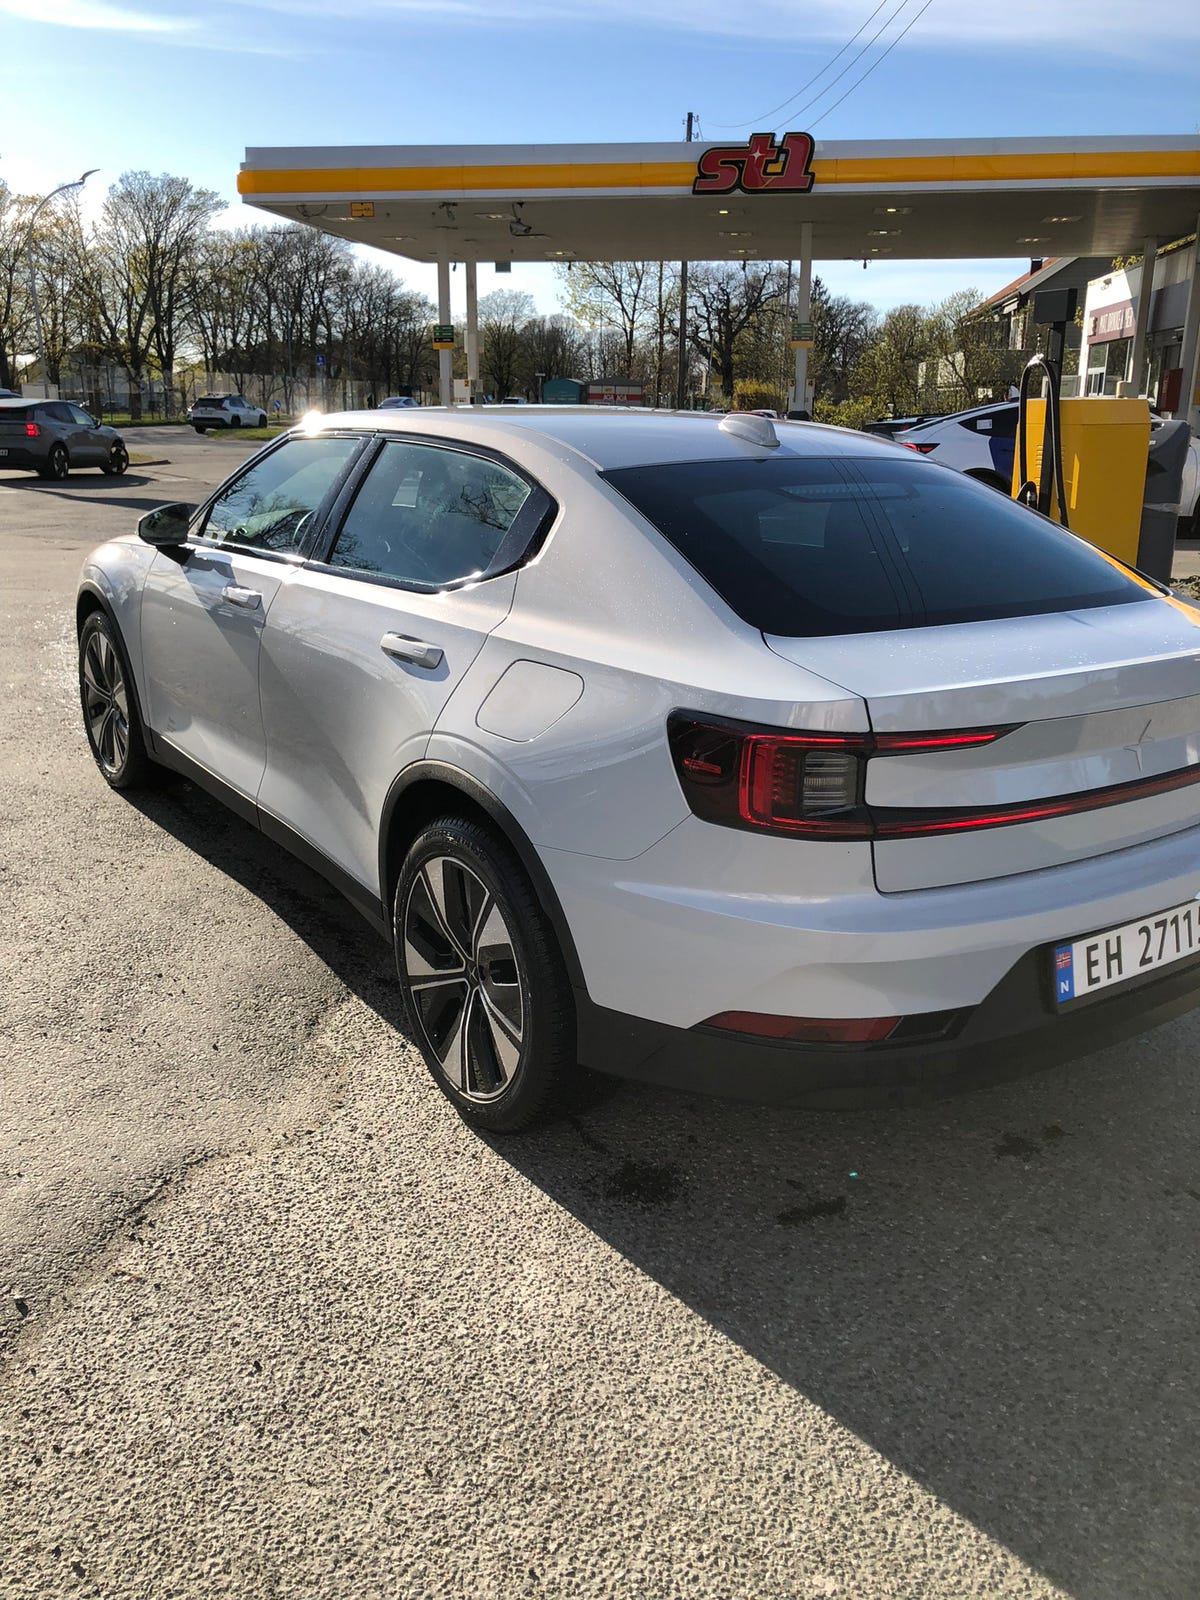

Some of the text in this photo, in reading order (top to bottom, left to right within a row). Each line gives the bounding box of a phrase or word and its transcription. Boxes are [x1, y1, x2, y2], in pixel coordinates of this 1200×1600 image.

[1086, 905, 1200, 986] EH 2711
[1060, 980, 1069, 993] N
